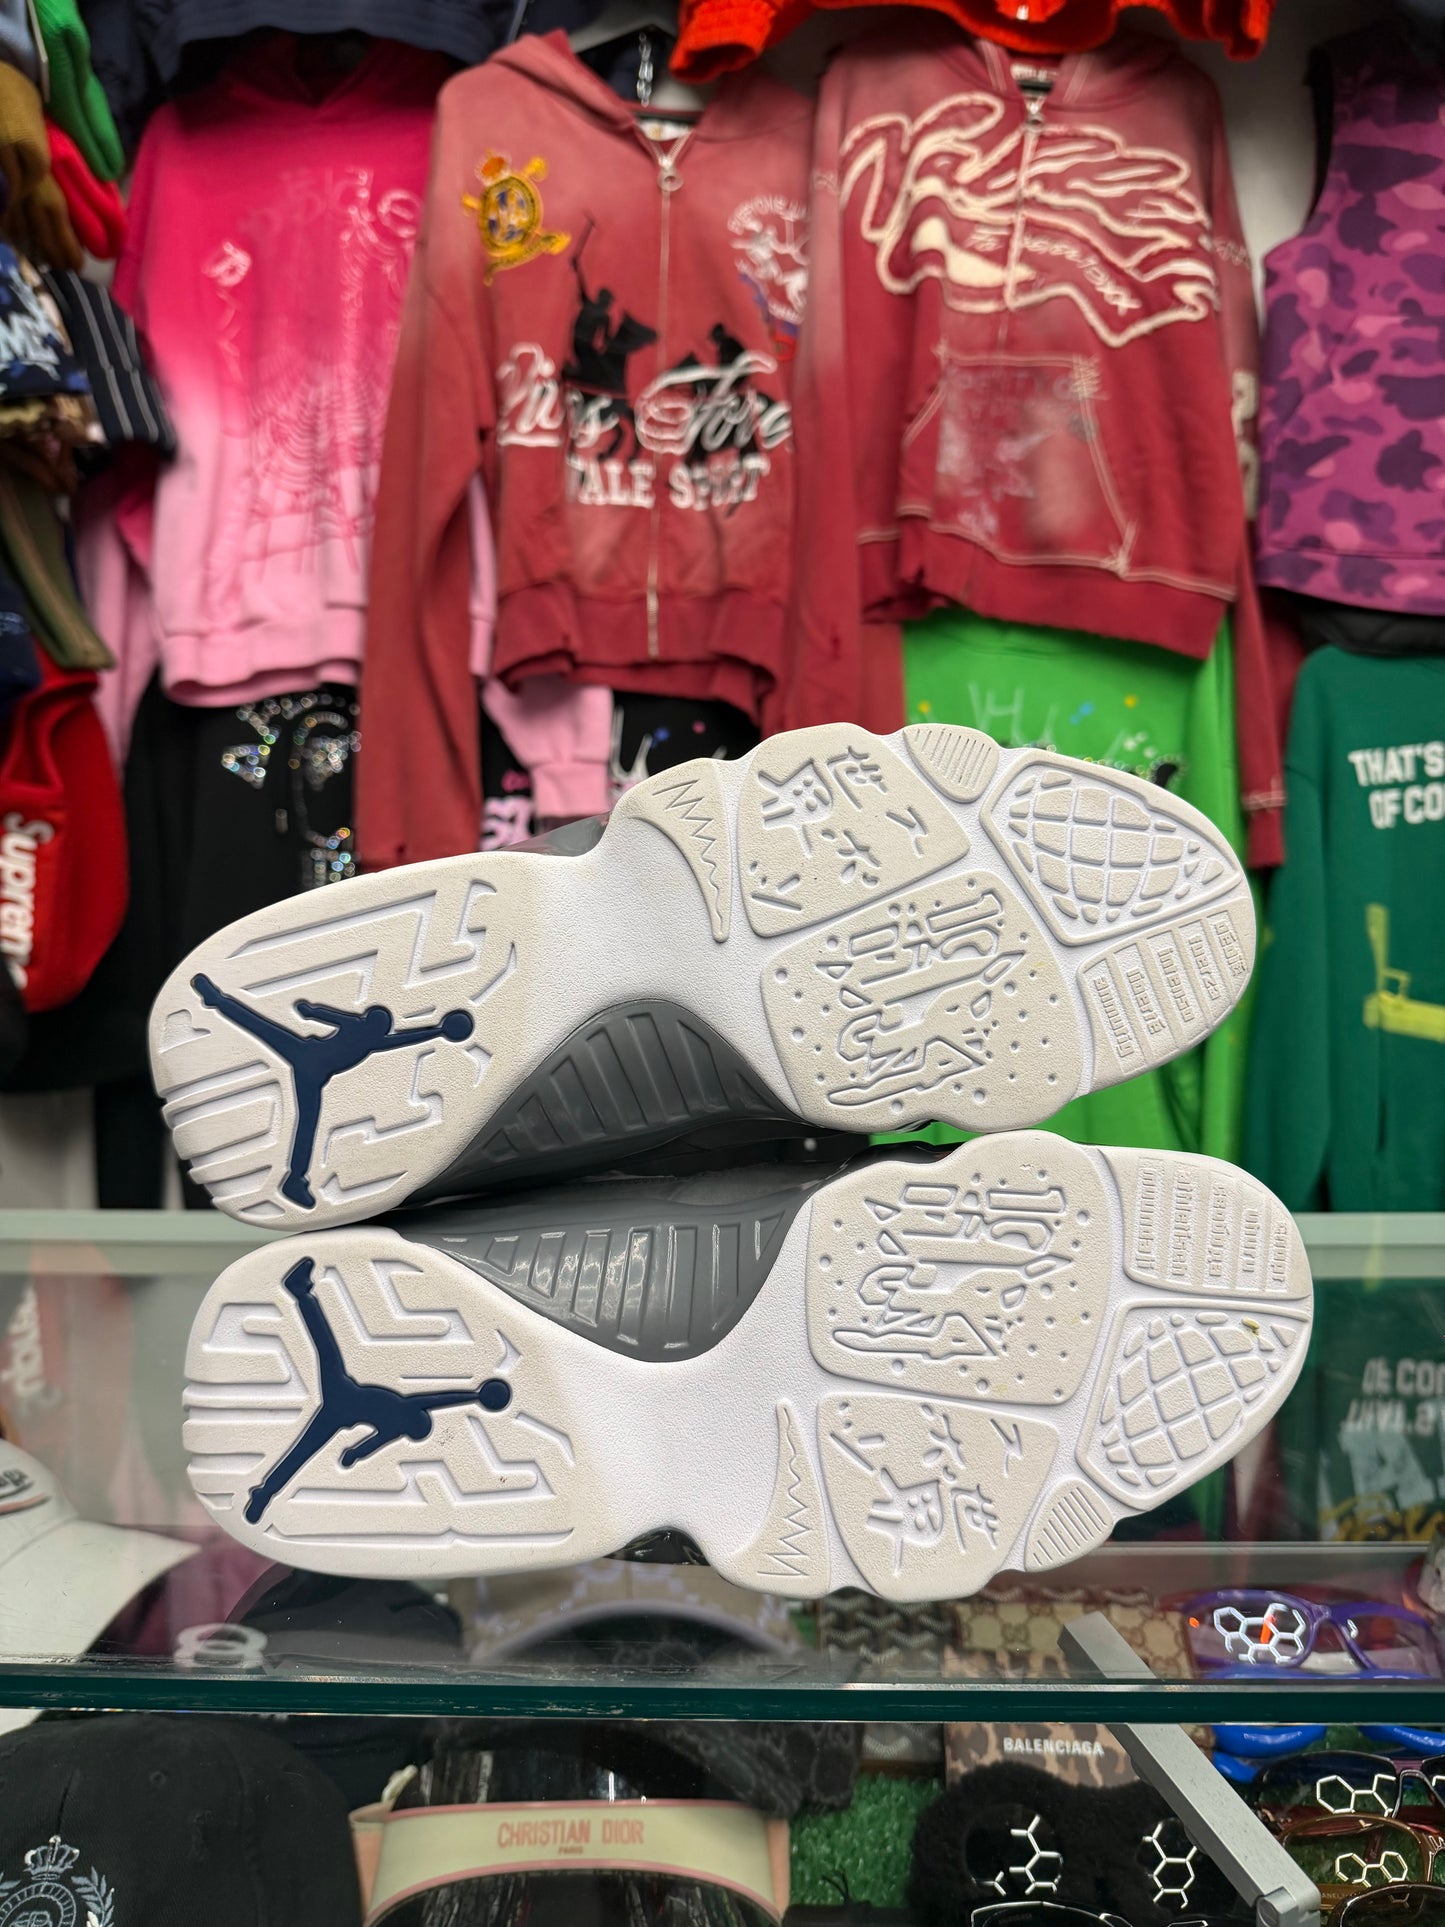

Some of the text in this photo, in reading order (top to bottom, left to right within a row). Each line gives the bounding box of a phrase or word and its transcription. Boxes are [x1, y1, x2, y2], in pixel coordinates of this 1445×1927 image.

[1368, 781, 1445, 829] OF CO
[1127, 967, 1166, 1035] liberté
[1157, 947, 1195, 1023] intenso
[1188, 934, 1222, 1001] fuerza
[1094, 976, 1136, 1058] anmutig
[1172, 1176, 1193, 1275] athletisch
[1003, 1737, 1105, 1758] BALENCIAGA
[497, 1818, 645, 1848] CHRISTIAN DIOR
